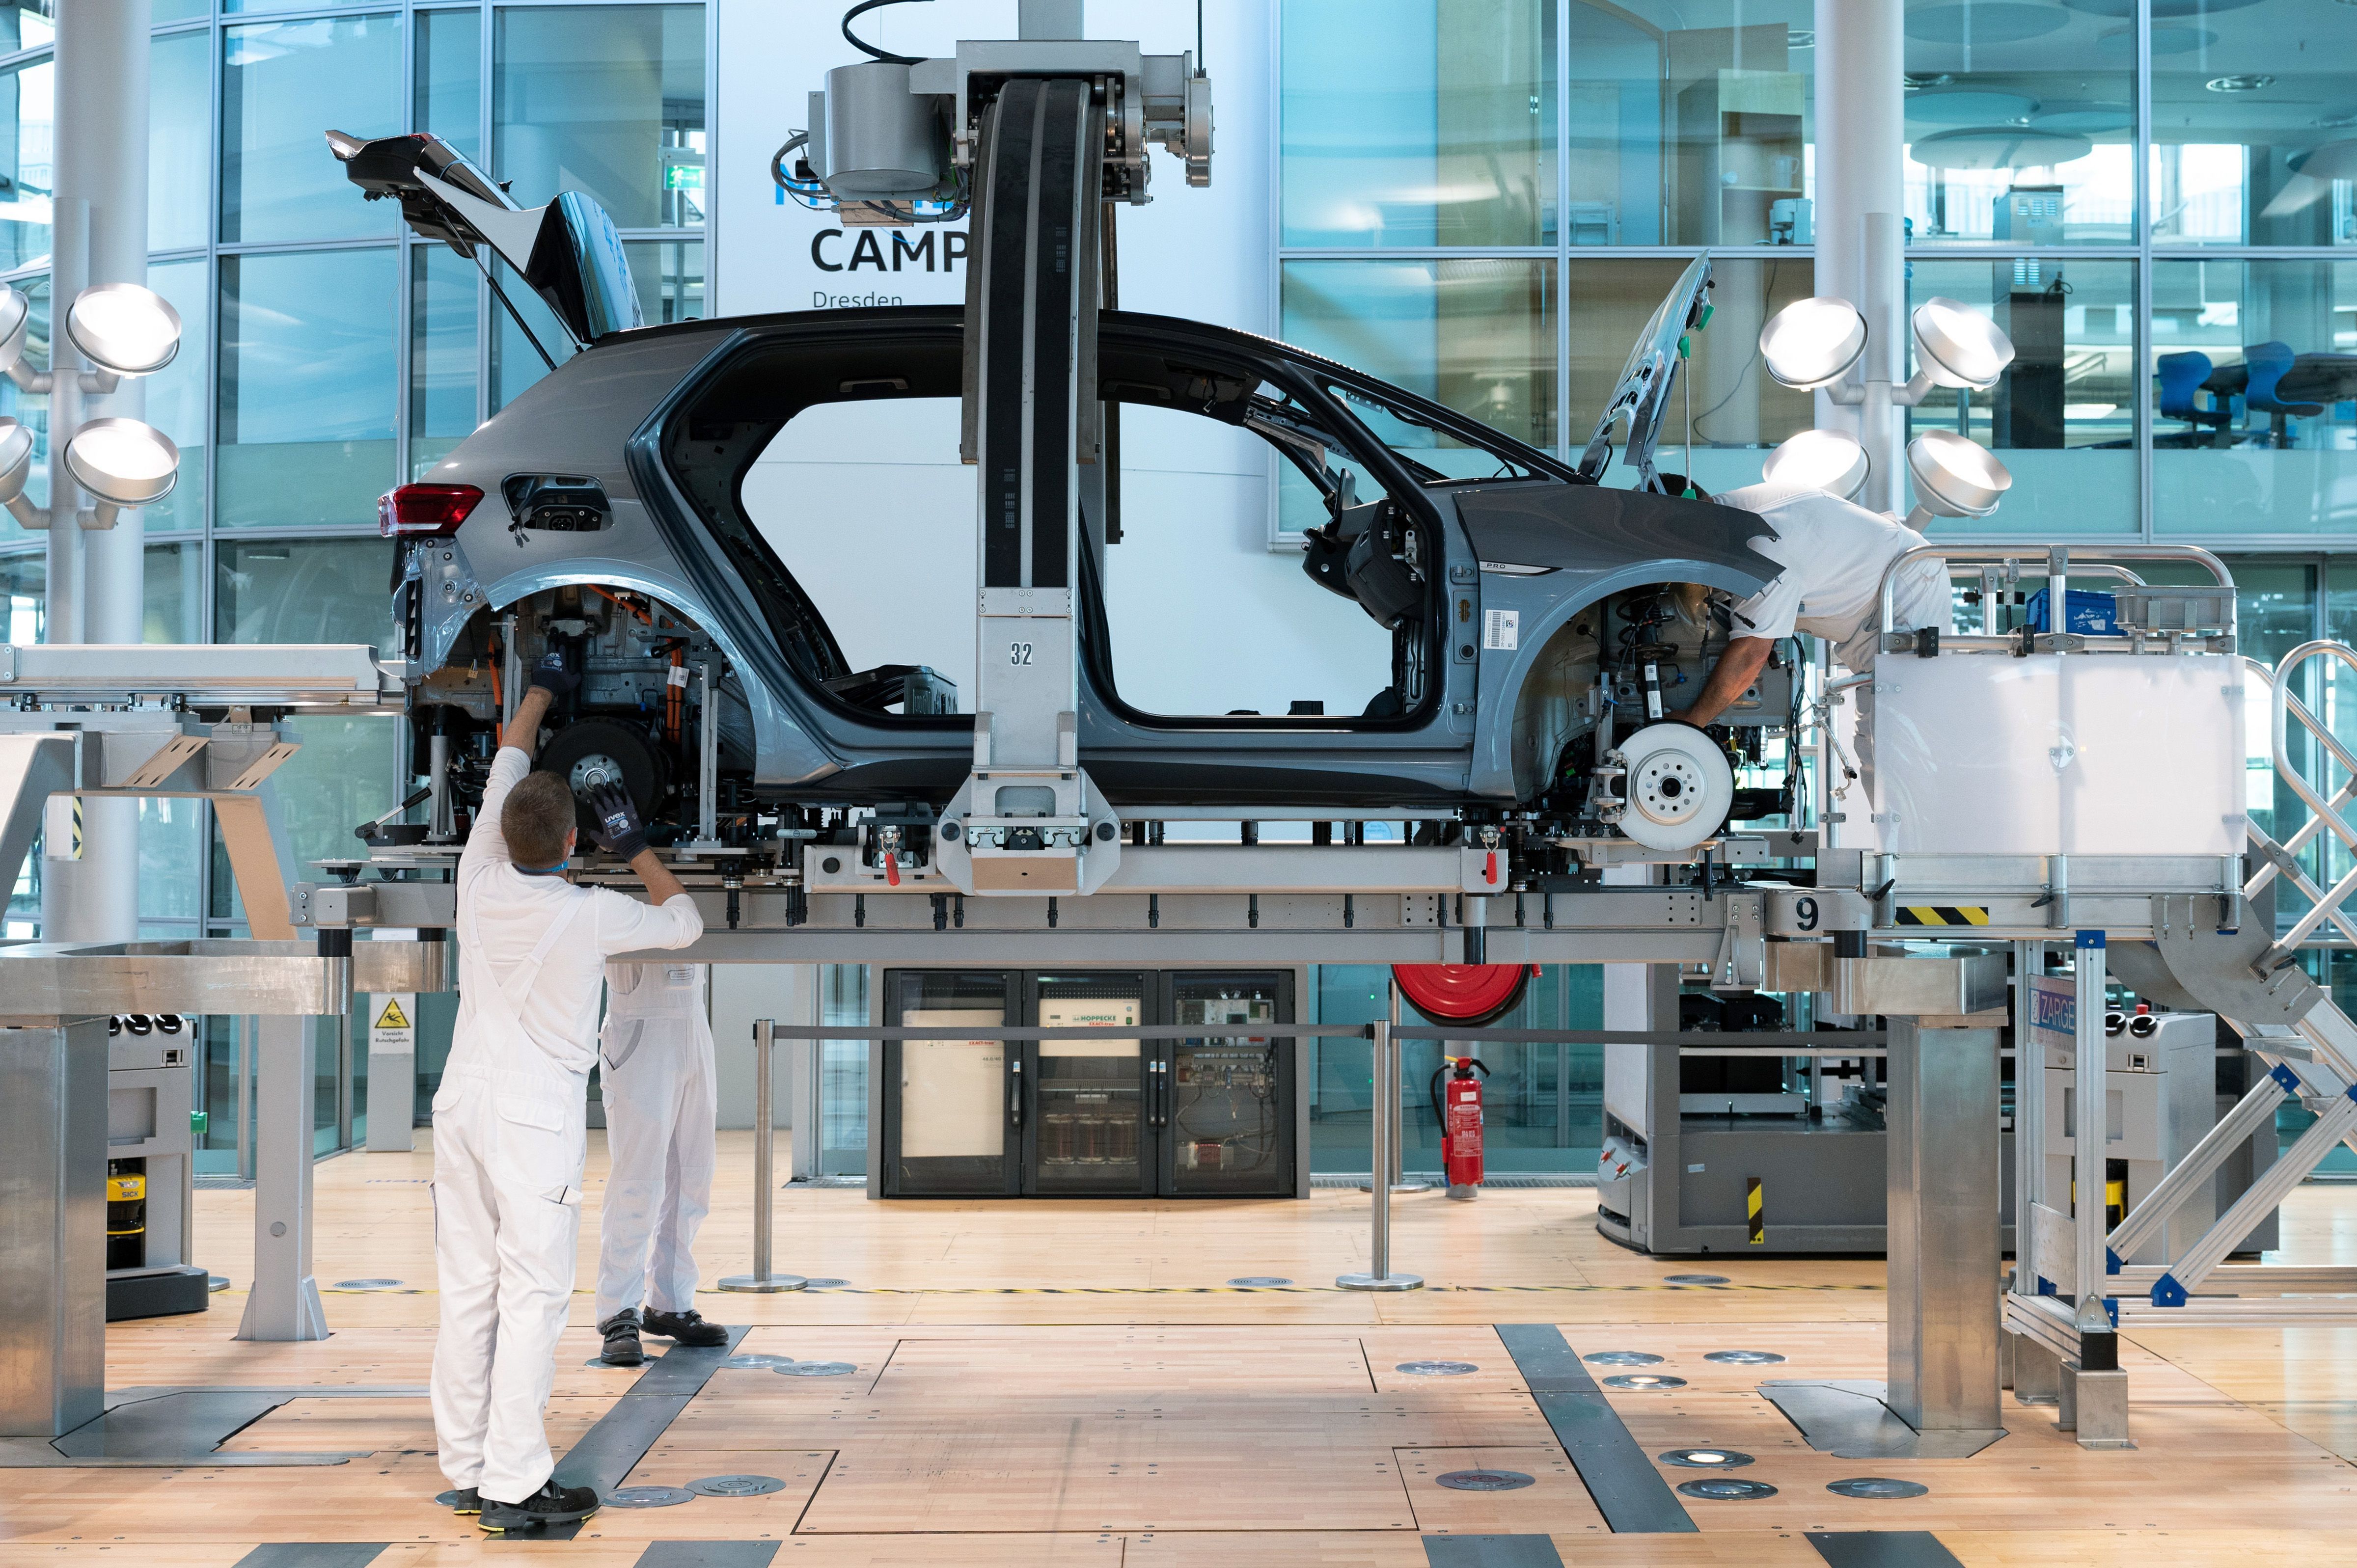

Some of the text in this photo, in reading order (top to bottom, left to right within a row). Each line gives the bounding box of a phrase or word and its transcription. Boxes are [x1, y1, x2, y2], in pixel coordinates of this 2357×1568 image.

[811, 229, 969, 272] CAMP
[814, 292, 903, 308] Dresden
[1012, 644, 1031, 664] 32
[604, 811, 625, 822] uvex
[1796, 897, 1819, 931] 9
[2041, 995, 2074, 1029] ZARGE
